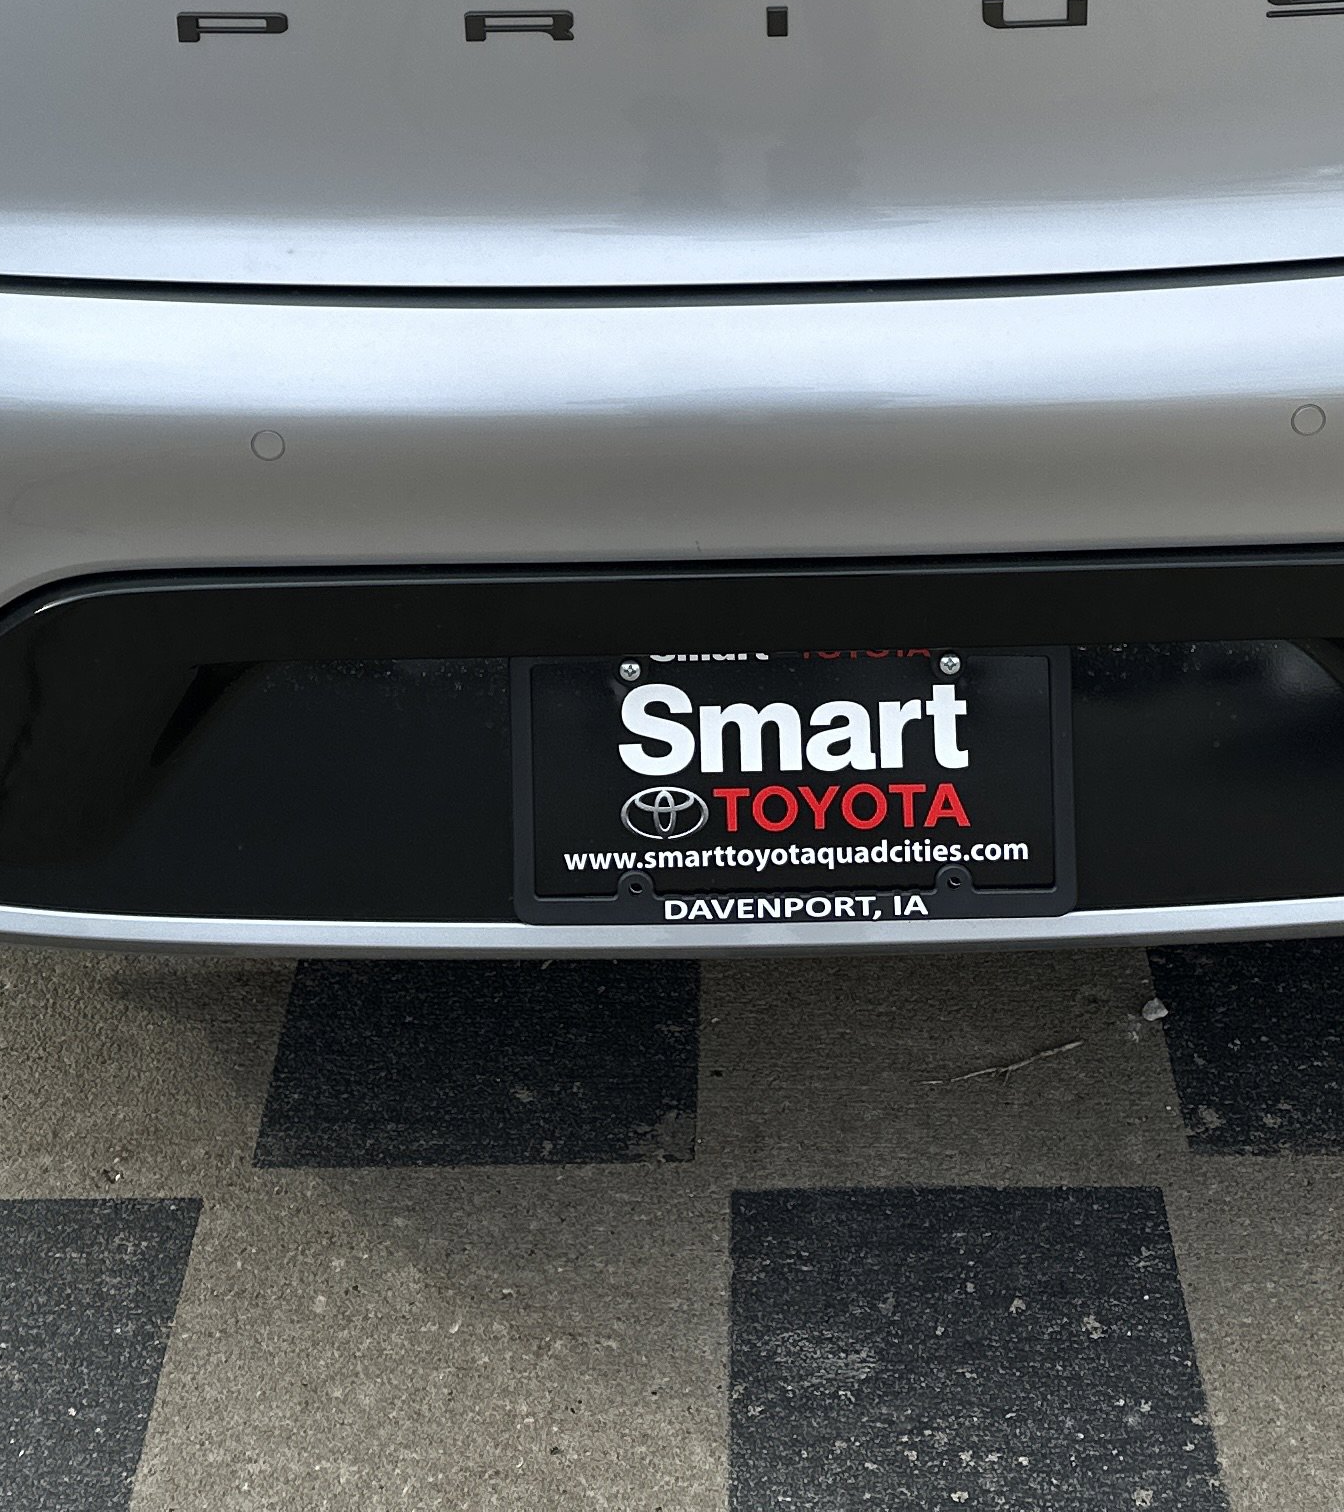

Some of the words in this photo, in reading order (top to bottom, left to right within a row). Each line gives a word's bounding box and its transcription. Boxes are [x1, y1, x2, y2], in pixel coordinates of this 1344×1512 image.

[618, 684, 969, 776] Smart
[713, 783, 972, 832] TOYOTA
[564, 838, 1029, 871] www.smarttoyotaquadcities.com
[664, 896, 883, 921] DAVENPORT,
[893, 895, 929, 917] IA
